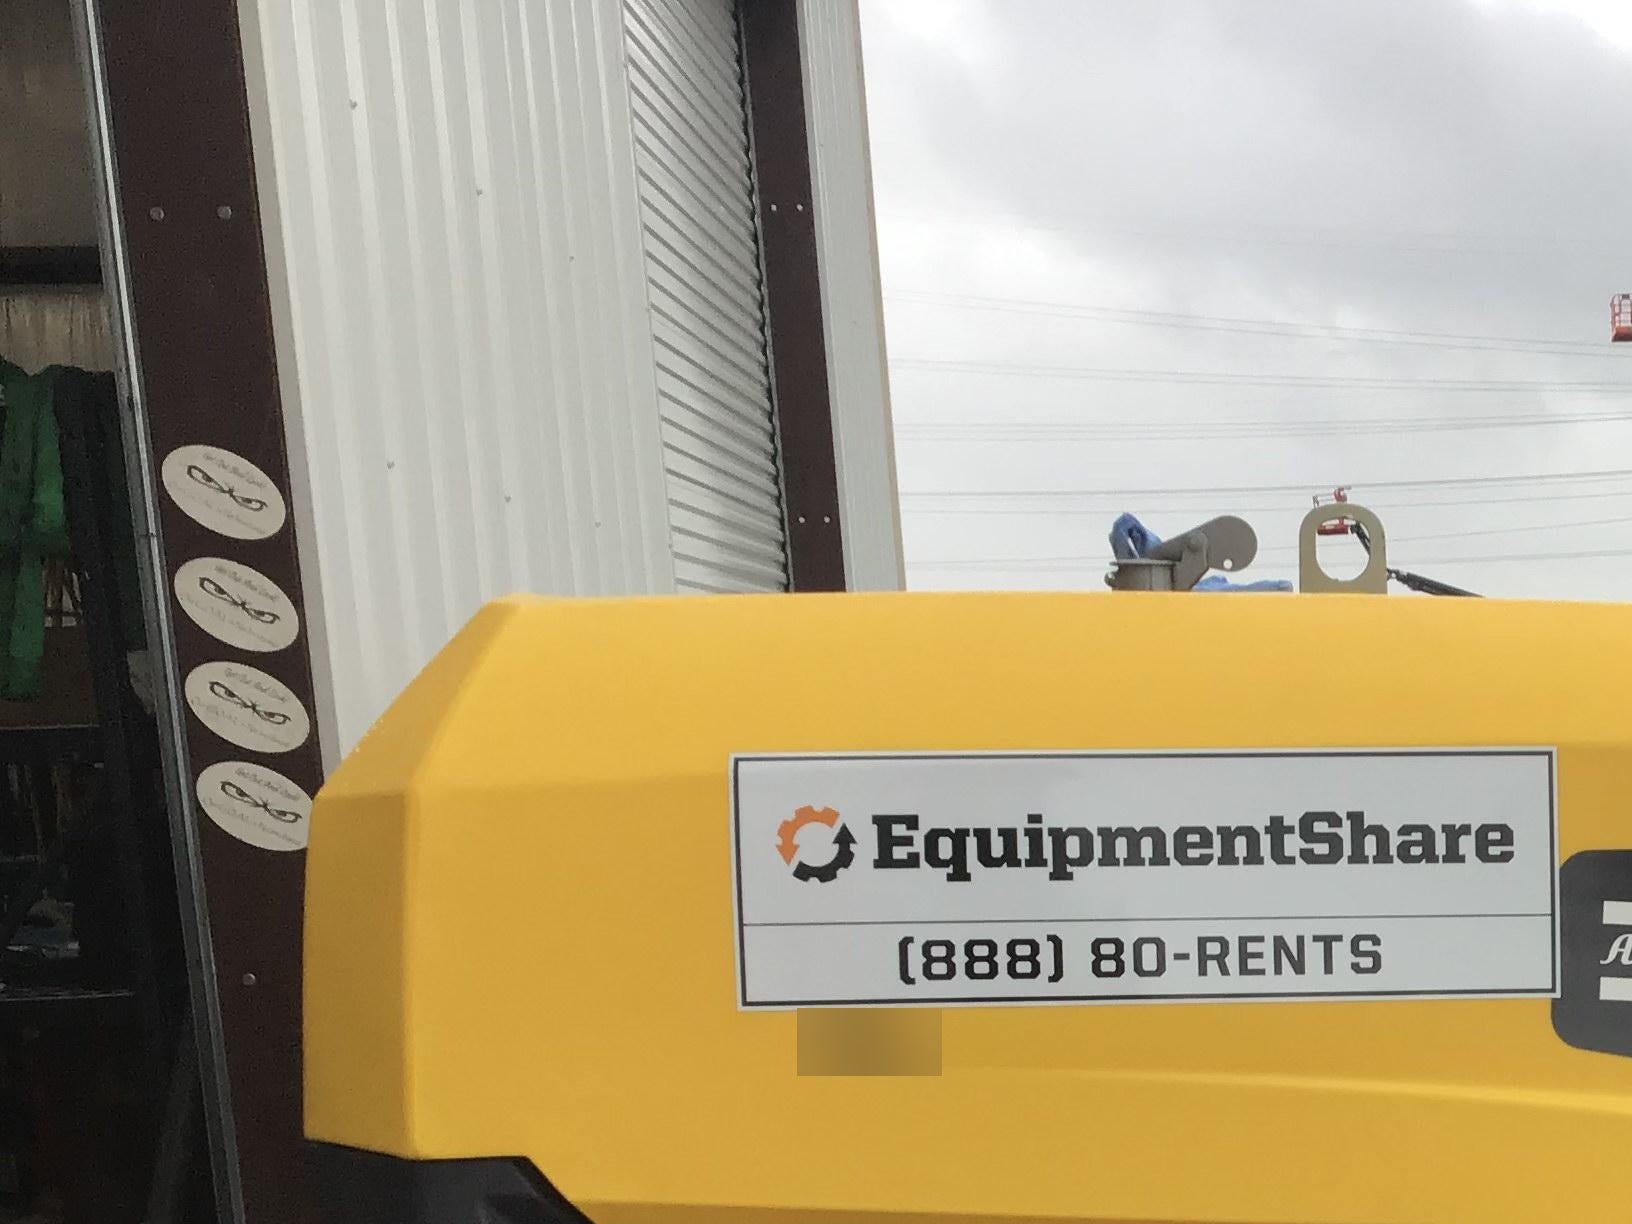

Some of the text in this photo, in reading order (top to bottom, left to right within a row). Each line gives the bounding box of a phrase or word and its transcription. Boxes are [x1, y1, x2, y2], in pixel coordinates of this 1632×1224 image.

[871, 810, 1515, 883] EquipmentShare
[898, 933, 1383, 986] (888) 80-RENTS
